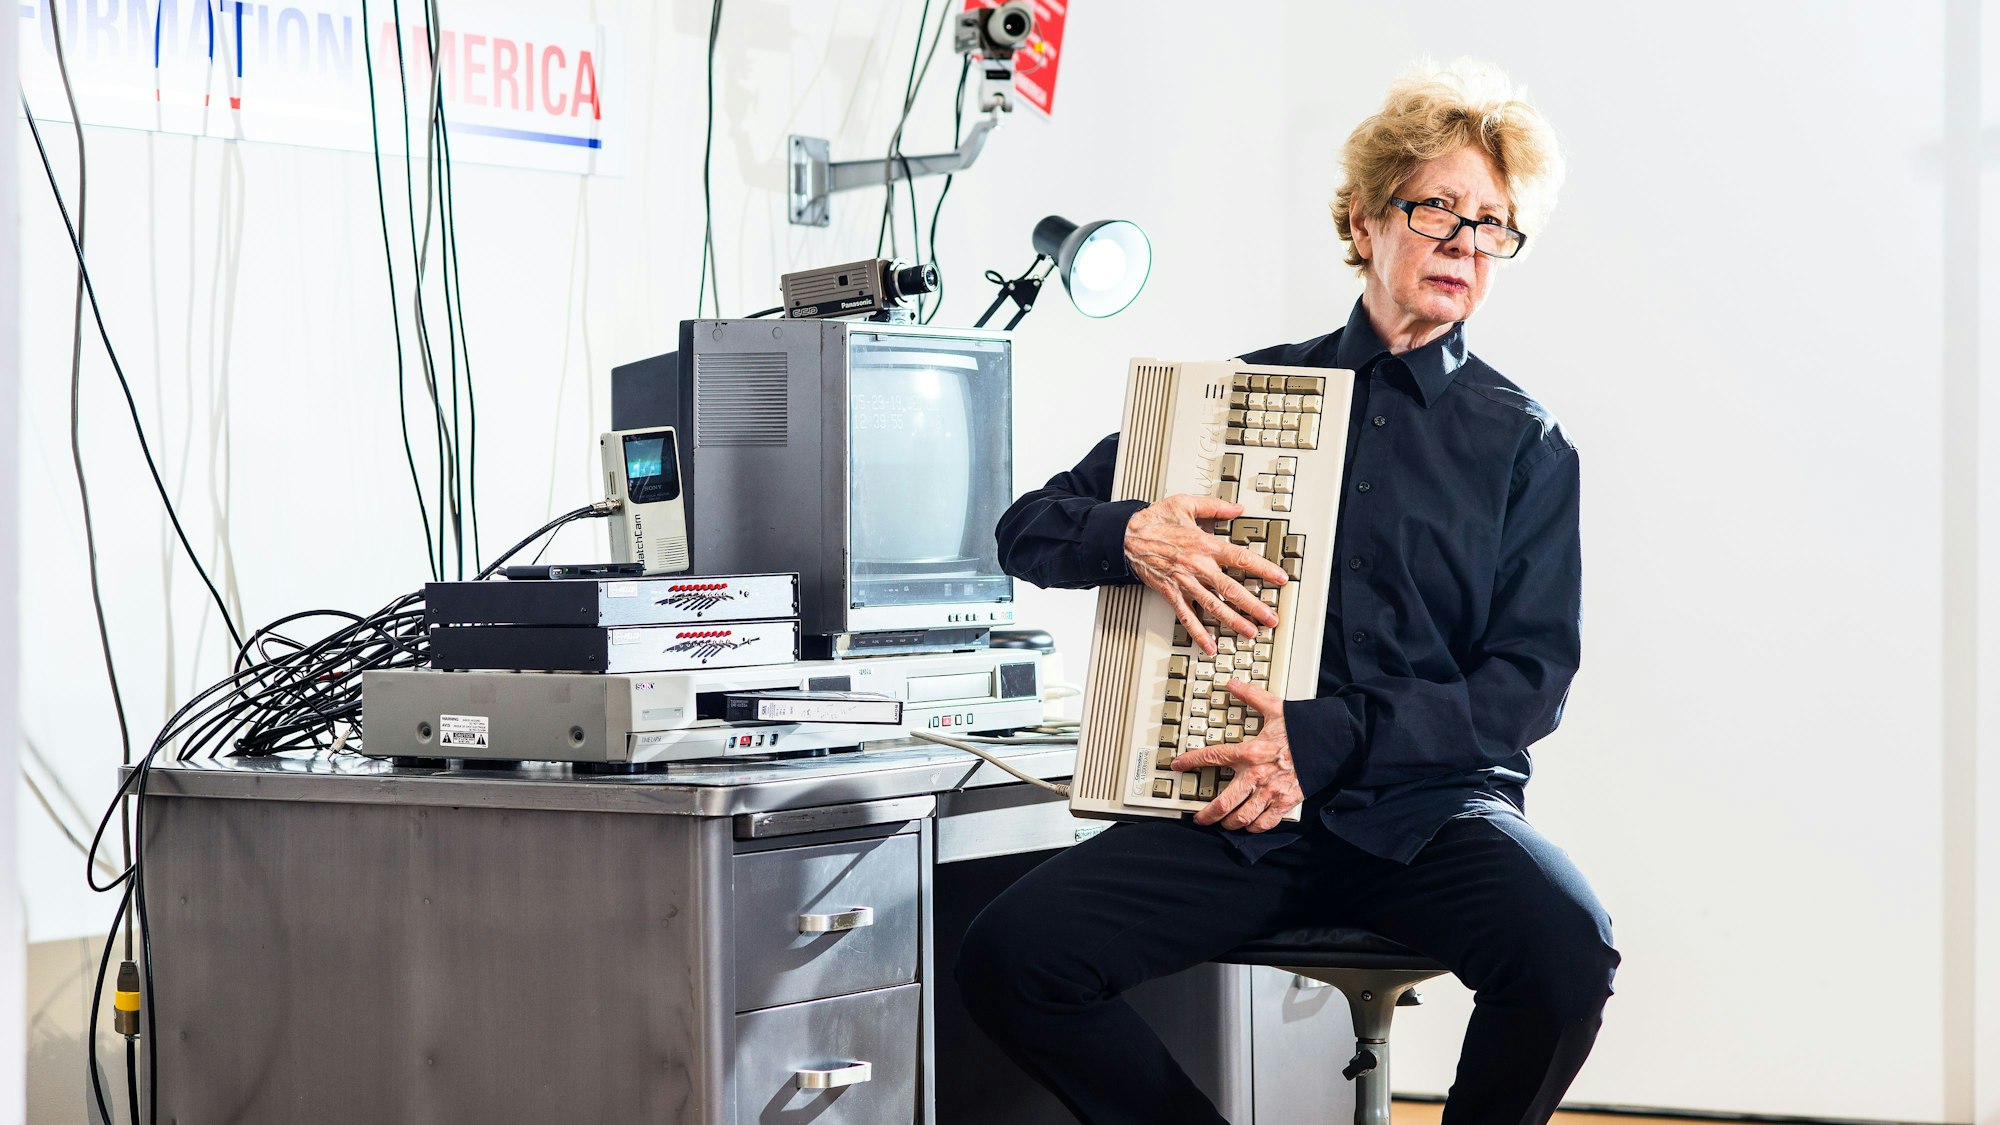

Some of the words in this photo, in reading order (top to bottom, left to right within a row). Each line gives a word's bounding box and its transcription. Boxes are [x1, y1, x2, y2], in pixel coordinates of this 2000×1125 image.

[18, 0, 353, 87] ORMATION
[376, 21, 602, 121] AMERICA
[841, 298, 872, 309] Panasonic
[635, 682, 655, 690] SONY
[1135, 752, 1143, 781] Commodore
